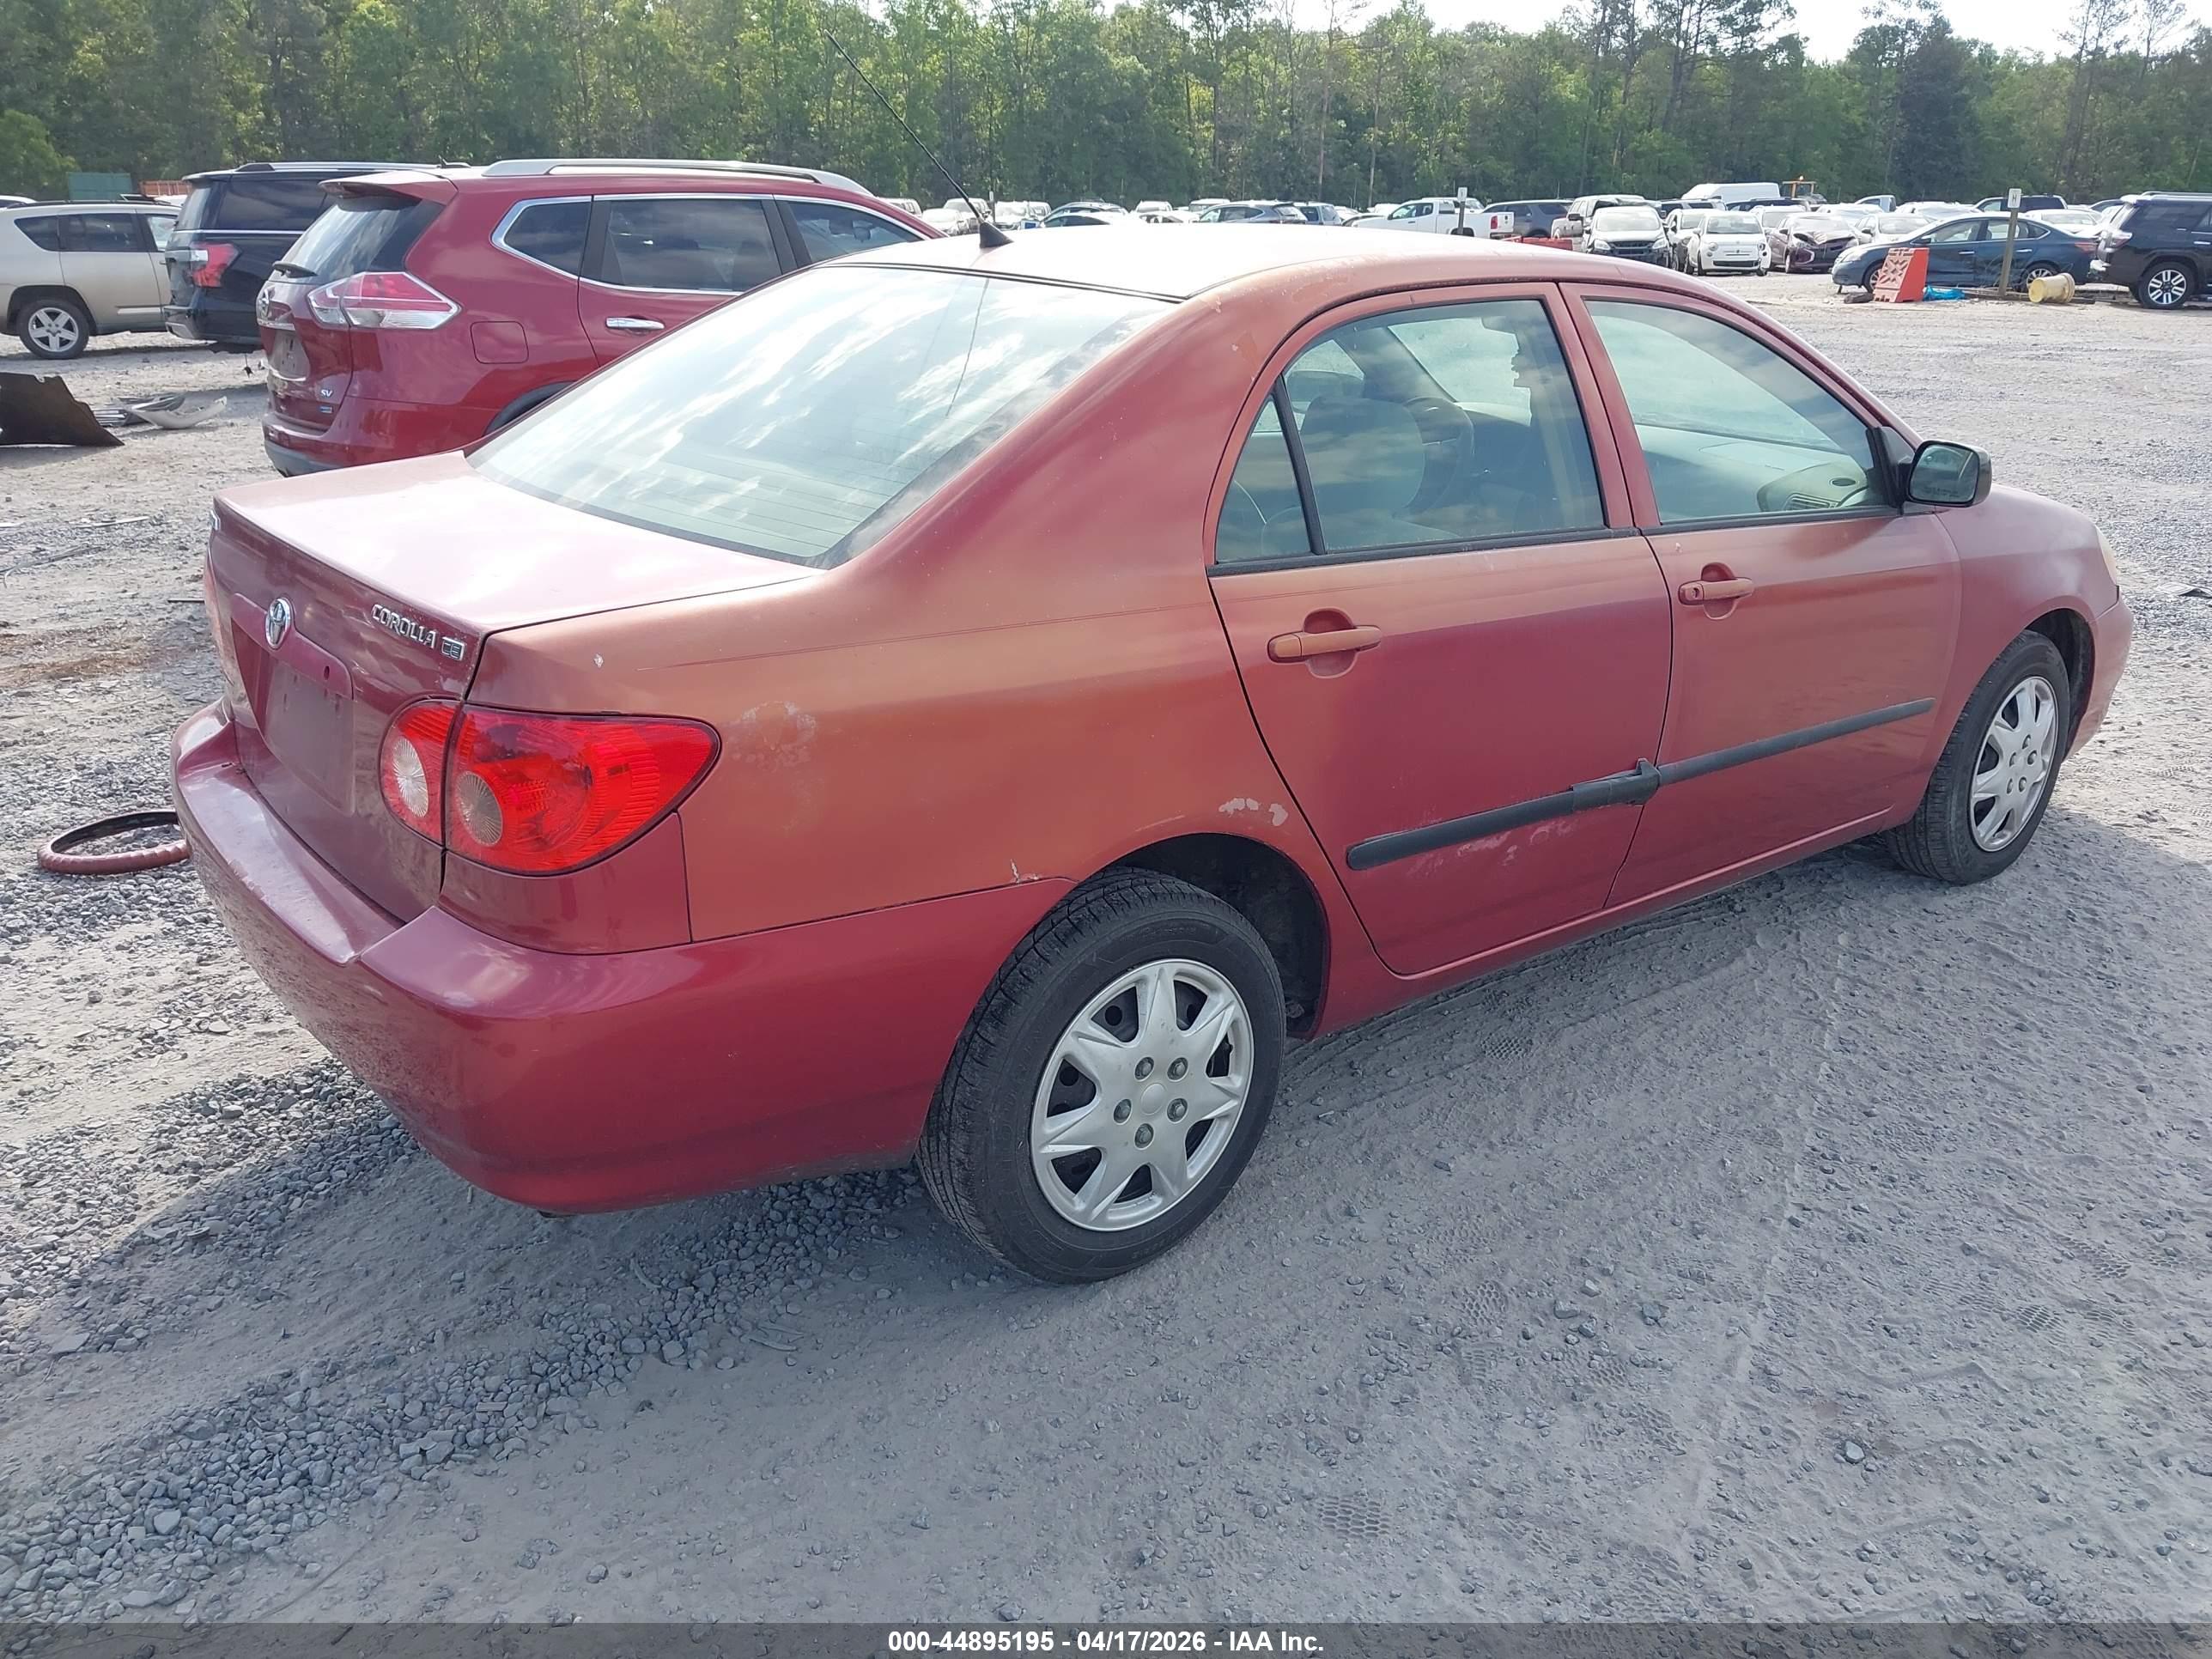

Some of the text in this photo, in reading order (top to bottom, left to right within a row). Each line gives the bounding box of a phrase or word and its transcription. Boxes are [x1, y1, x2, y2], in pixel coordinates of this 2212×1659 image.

[321, 389, 333, 398] SV
[371, 604, 465, 661] COROLLA CE
